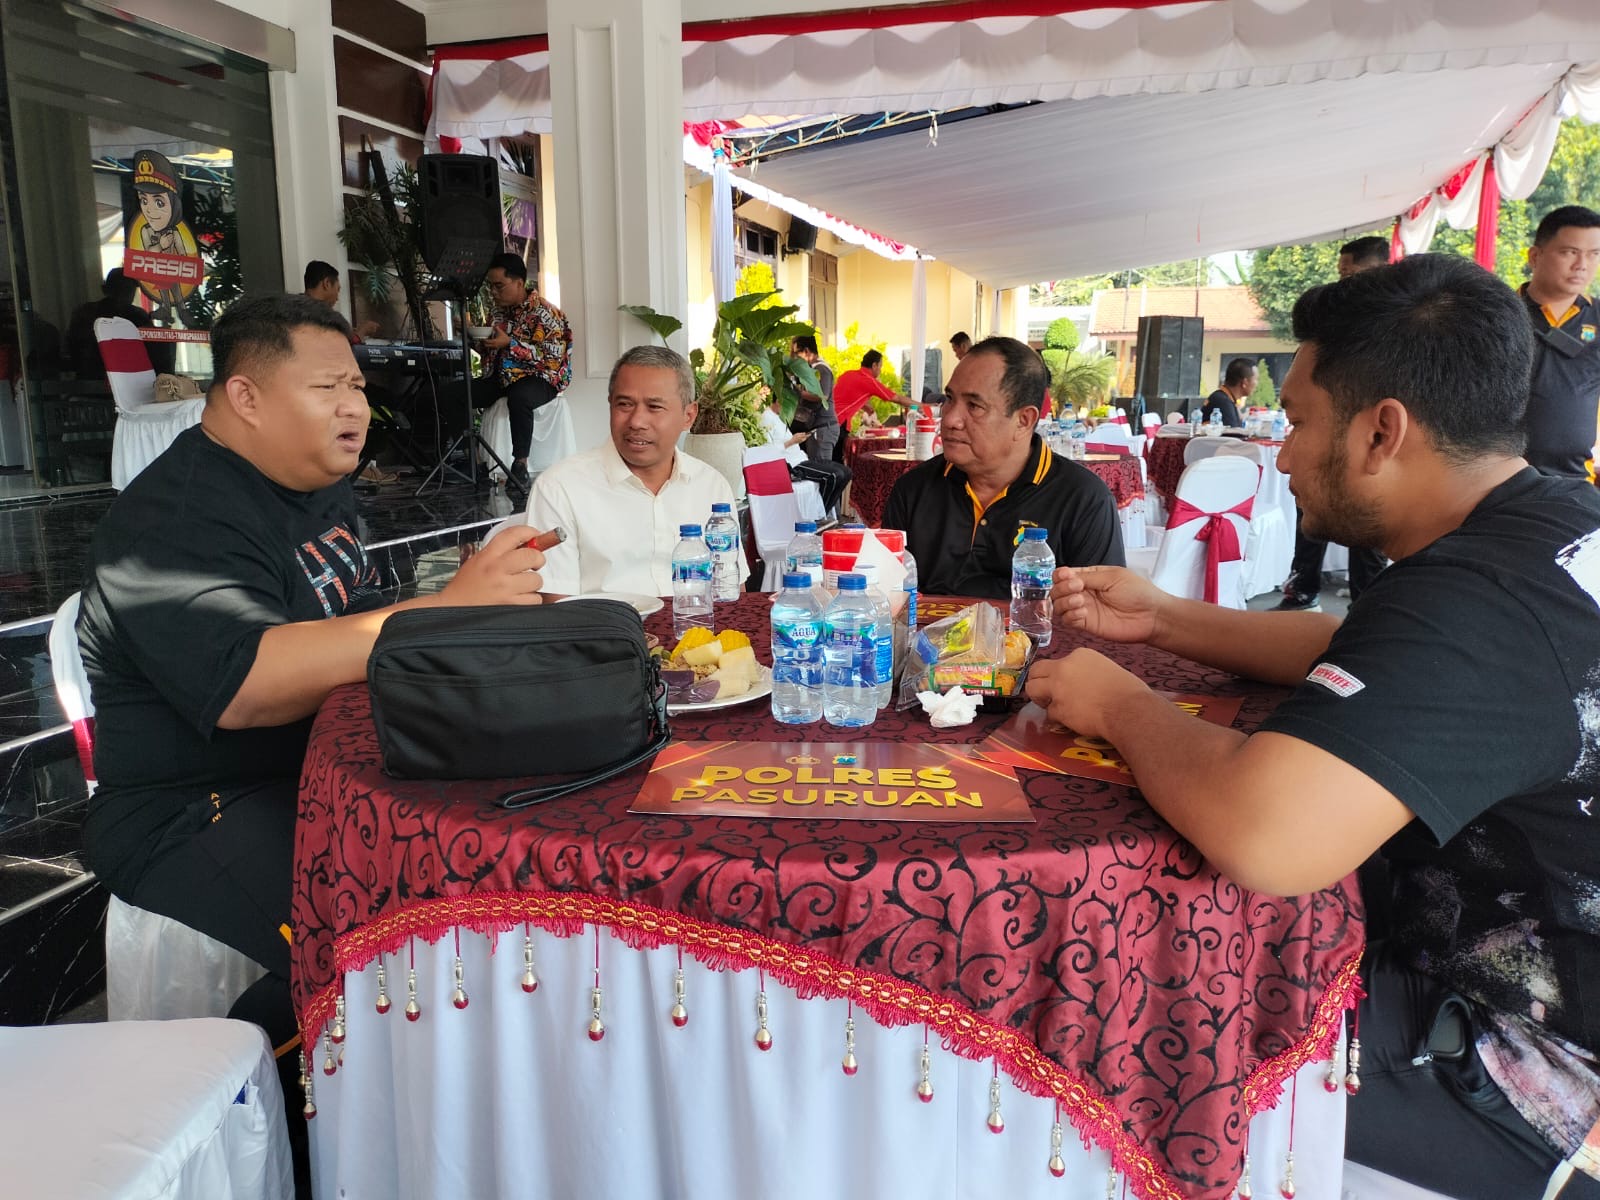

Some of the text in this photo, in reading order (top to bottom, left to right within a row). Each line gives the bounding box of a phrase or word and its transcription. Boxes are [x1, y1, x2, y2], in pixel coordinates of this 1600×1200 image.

[132, 255, 198, 279] PRESISI
[791, 627, 817, 637] AQUA
[701, 766, 957, 789] POLRES
[671, 788, 984, 808] PASURUAN
